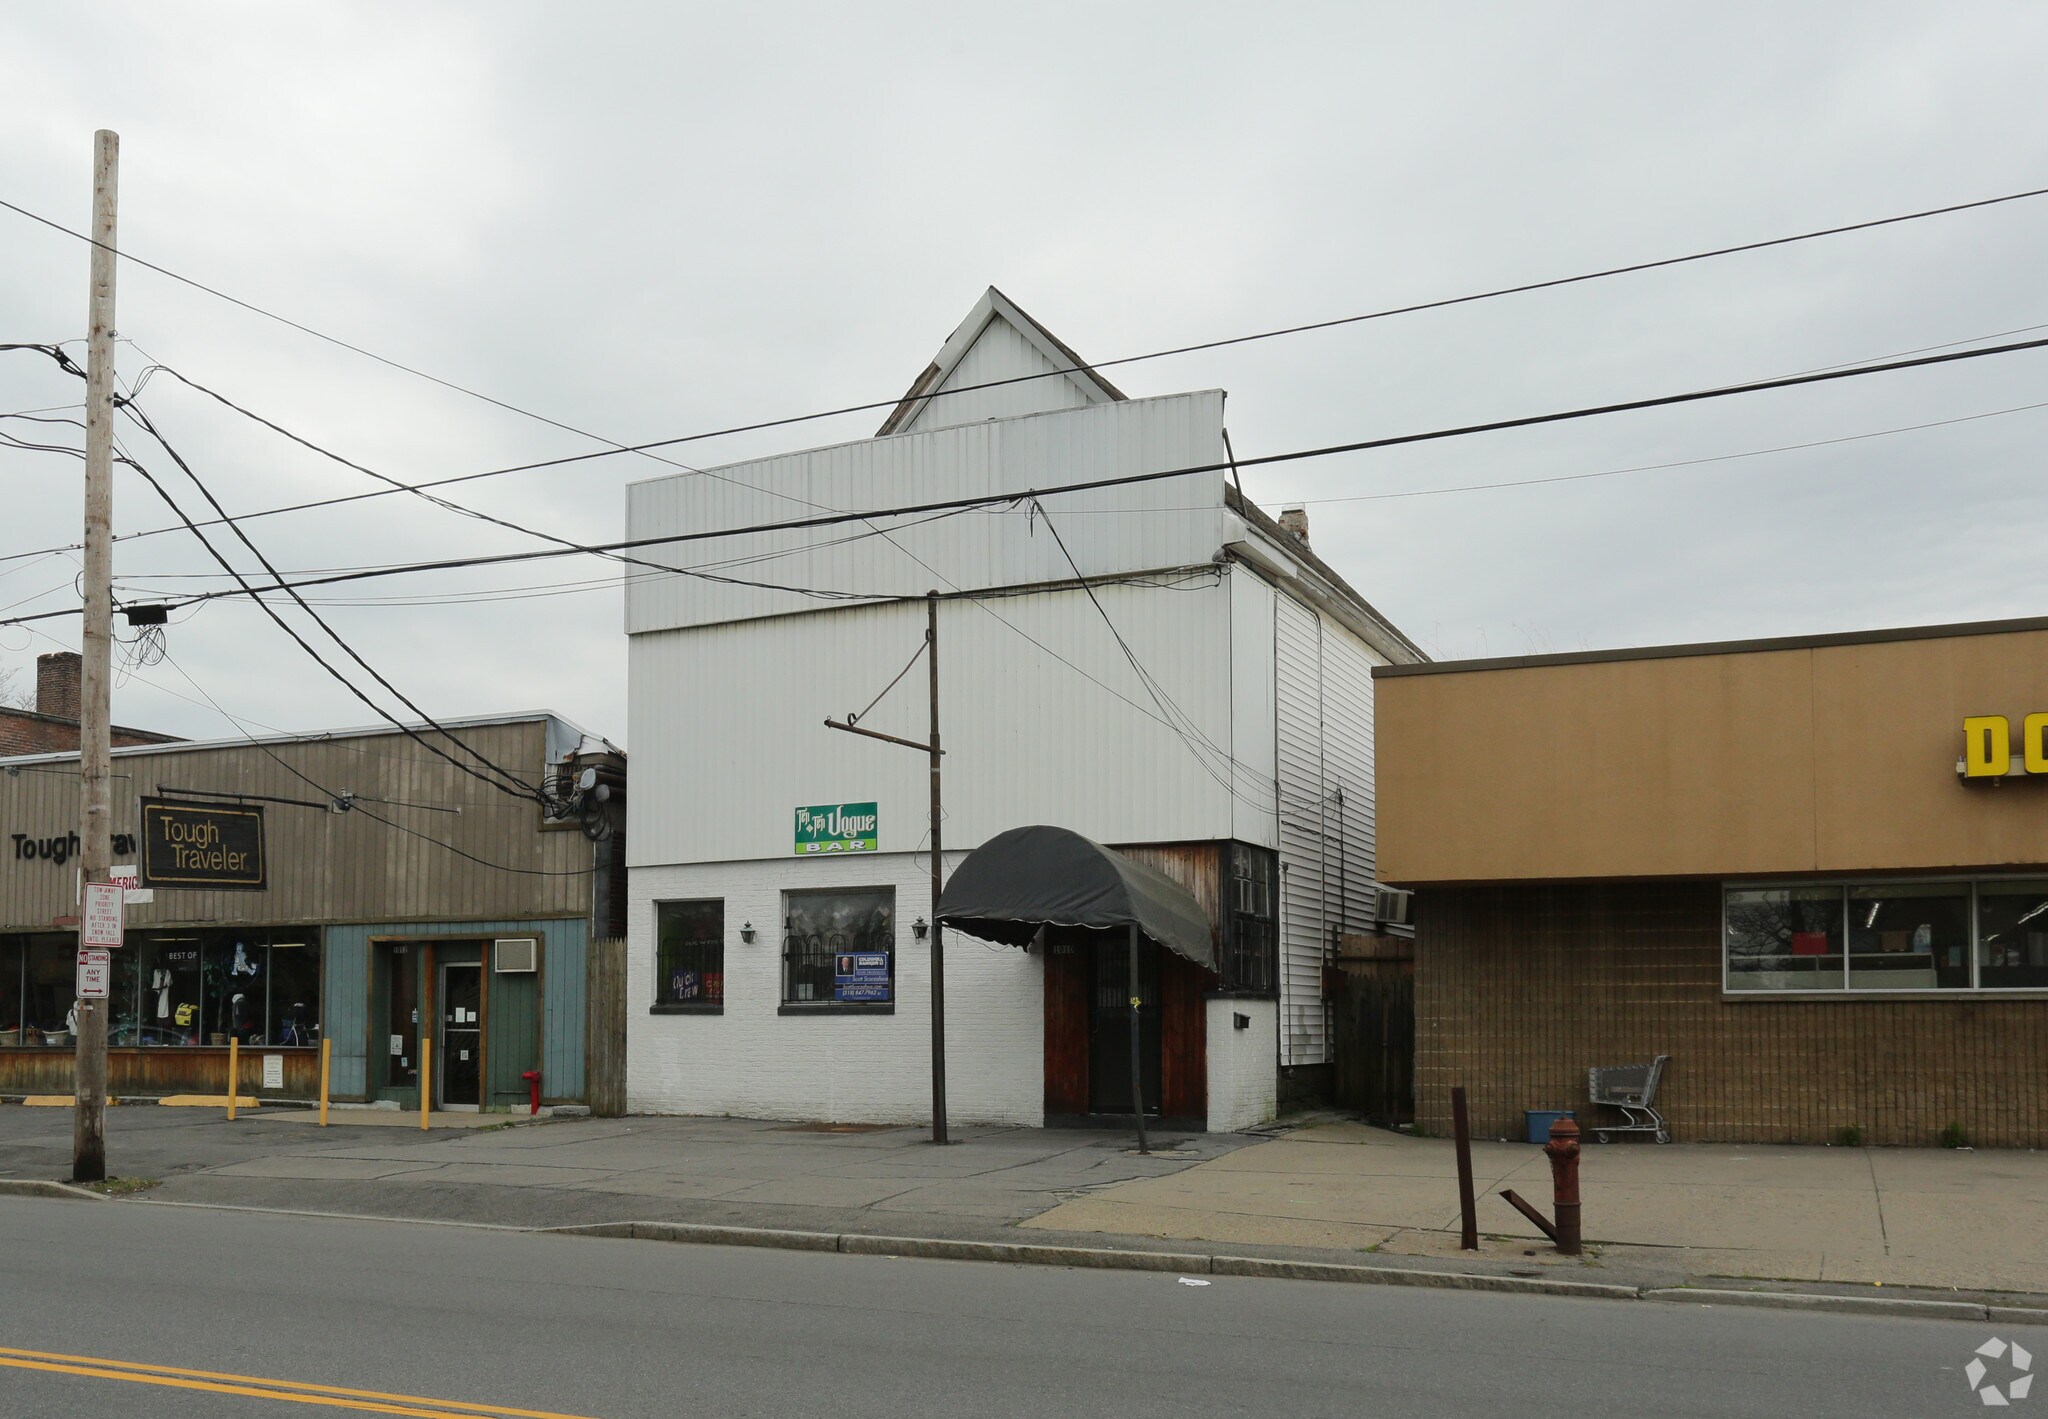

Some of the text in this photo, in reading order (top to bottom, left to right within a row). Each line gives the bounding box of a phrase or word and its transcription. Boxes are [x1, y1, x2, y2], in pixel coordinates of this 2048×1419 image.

[827, 804, 876, 839] Vogue
[159, 816, 219, 849] Tough
[11, 830, 81, 866] Tough
[806, 841, 865, 852] BAR
[171, 844, 248, 871] Traveler
[79, 954, 88, 964] NO
[168, 951, 197, 960] BEST OF
[86, 975, 100, 983] TIME
